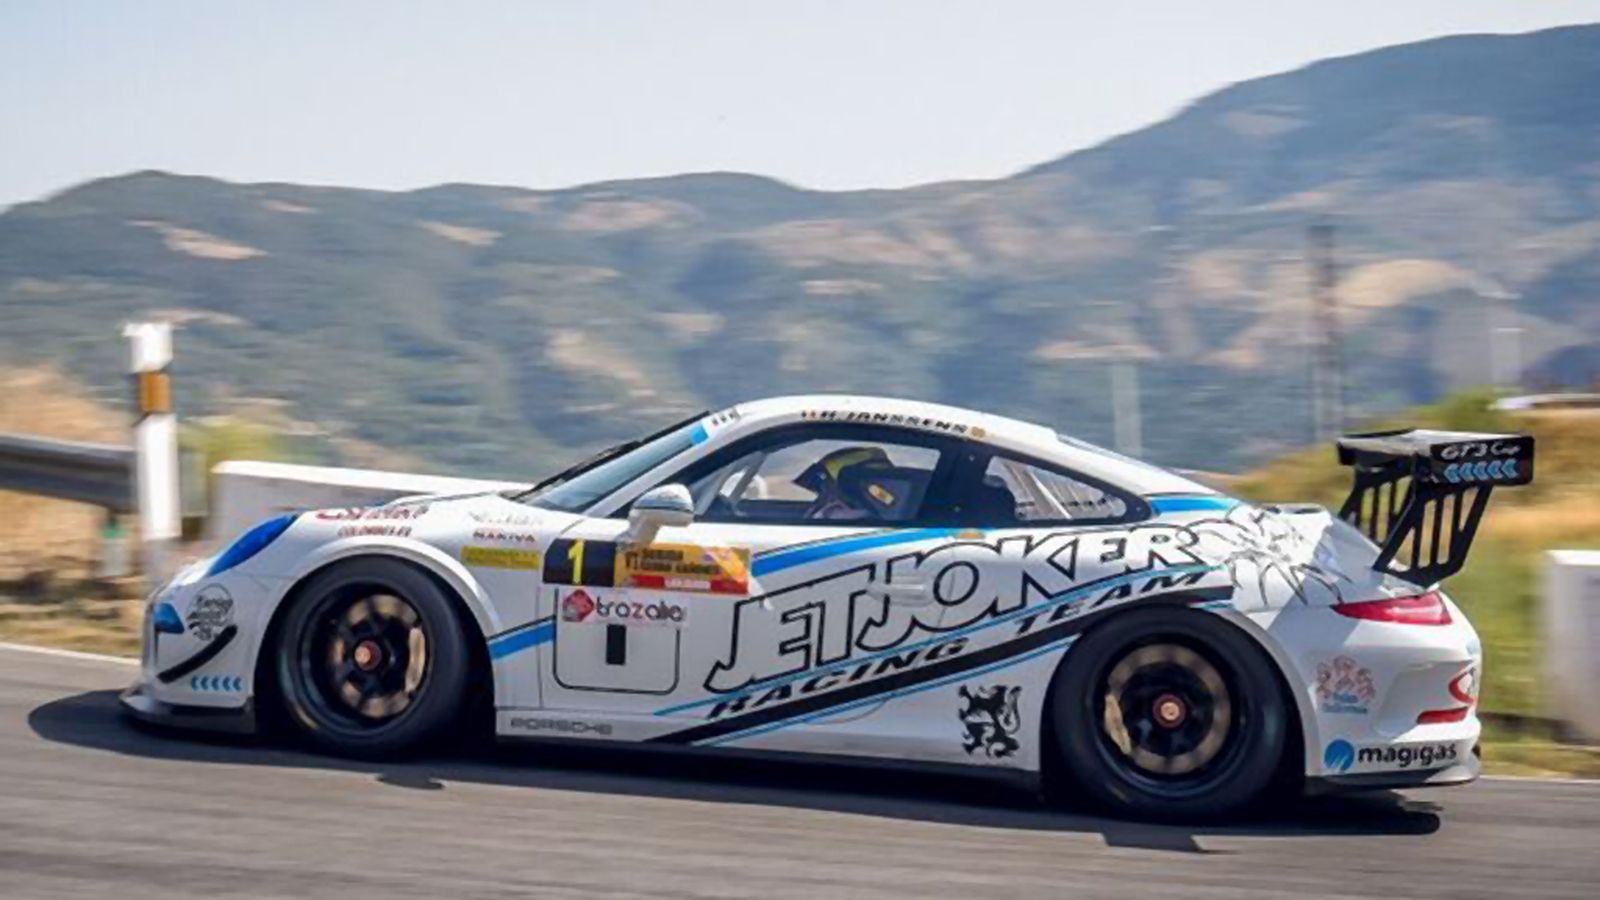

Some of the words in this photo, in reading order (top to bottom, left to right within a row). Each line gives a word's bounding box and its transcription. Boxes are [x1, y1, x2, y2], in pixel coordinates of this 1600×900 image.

[847, 410, 968, 433] JANSSENS
[1441, 442, 1488, 460] GT3
[567, 539, 586, 584] 1
[708, 637, 969, 719] RACING
[1016, 566, 1204, 636] TEAM
[510, 717, 613, 735] PORSCHE
[1358, 743, 1457, 768] magigas
